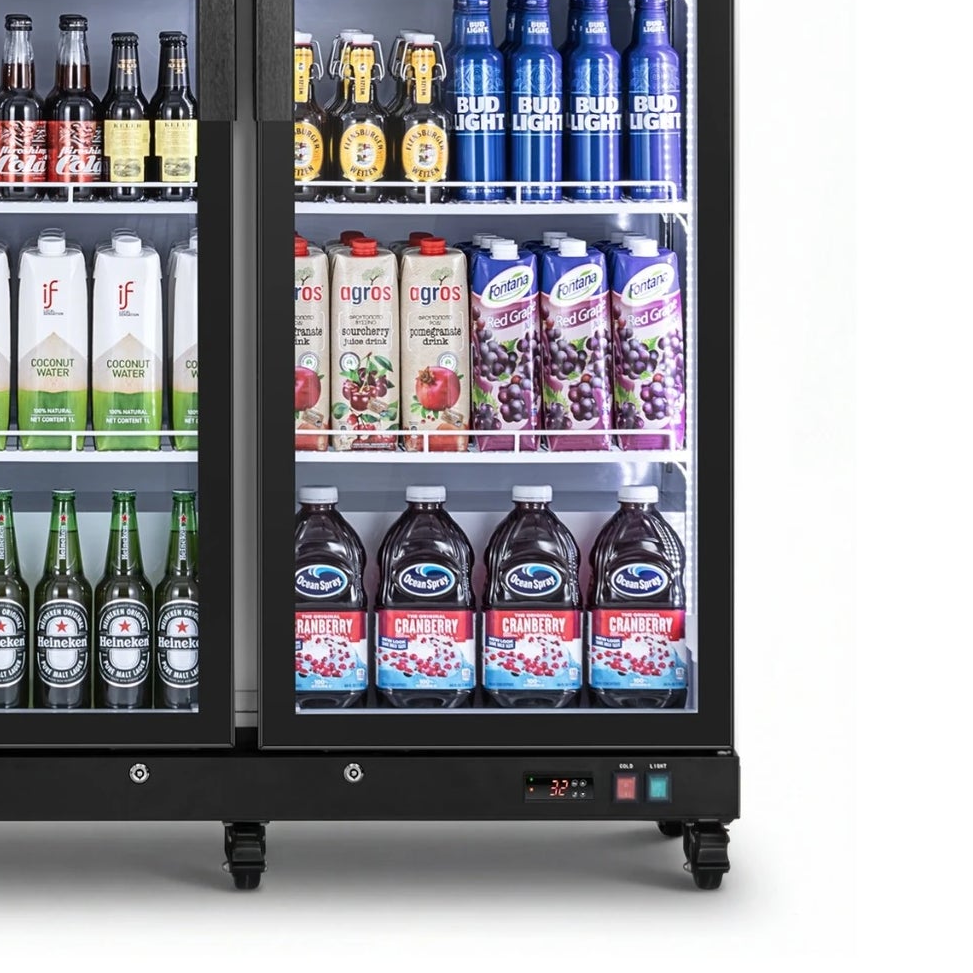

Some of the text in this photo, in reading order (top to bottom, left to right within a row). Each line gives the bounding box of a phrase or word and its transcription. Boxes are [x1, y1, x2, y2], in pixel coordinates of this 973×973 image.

[469, 20, 485, 28] BUD
[530, 20, 547, 28] BUD
[588, 20, 604, 28] BUD
[456, 96, 500, 114] BUD
[518, 96, 560, 114] BUD
[576, 96, 619, 114] BUD
[634, 95, 677, 113] BUD
[454, 114, 505, 131] LIGHT
[513, 114, 563, 131] LIGHT
[571, 114, 622, 131] LIGHT
[630, 113, 681, 130] LIGHT
[350, 165, 378, 177] WEIZEN
[411, 166, 440, 178] WEIZEN
[43, 279, 58, 309] if
[489, 273, 529, 299] Fontana
[557, 273, 597, 299] Fontana
[118, 281, 134, 310] if
[340, 286, 391, 305] agros
[410, 286, 461, 305] agros
[487, 311, 508, 329] Red
[556, 310, 578, 328] Red
[342, 327, 389, 338] sourcherry
[409, 328, 461, 339] pomegranate
[423, 338, 449, 346] drink
[31, 358, 75, 368] COCONUT
[107, 359, 151, 369] COCONUT
[36, 367, 69, 377] WATER
[112, 368, 145, 378] WATER
[403, 574, 450, 590] Ocean Spray
[510, 574, 557, 590] Ocean Spray
[63, 608, 85, 629] ORIGINAL
[394, 618, 458, 634] CRANBERRY
[502, 617, 565, 633] CRANBERRY
[609, 617, 672, 633] CRANBERRY
[37, 635, 87, 647] Heineken
[99, 635, 149, 647] Heineken
[53, 670, 70, 679] MALT
[549, 779, 569, 796] 32
